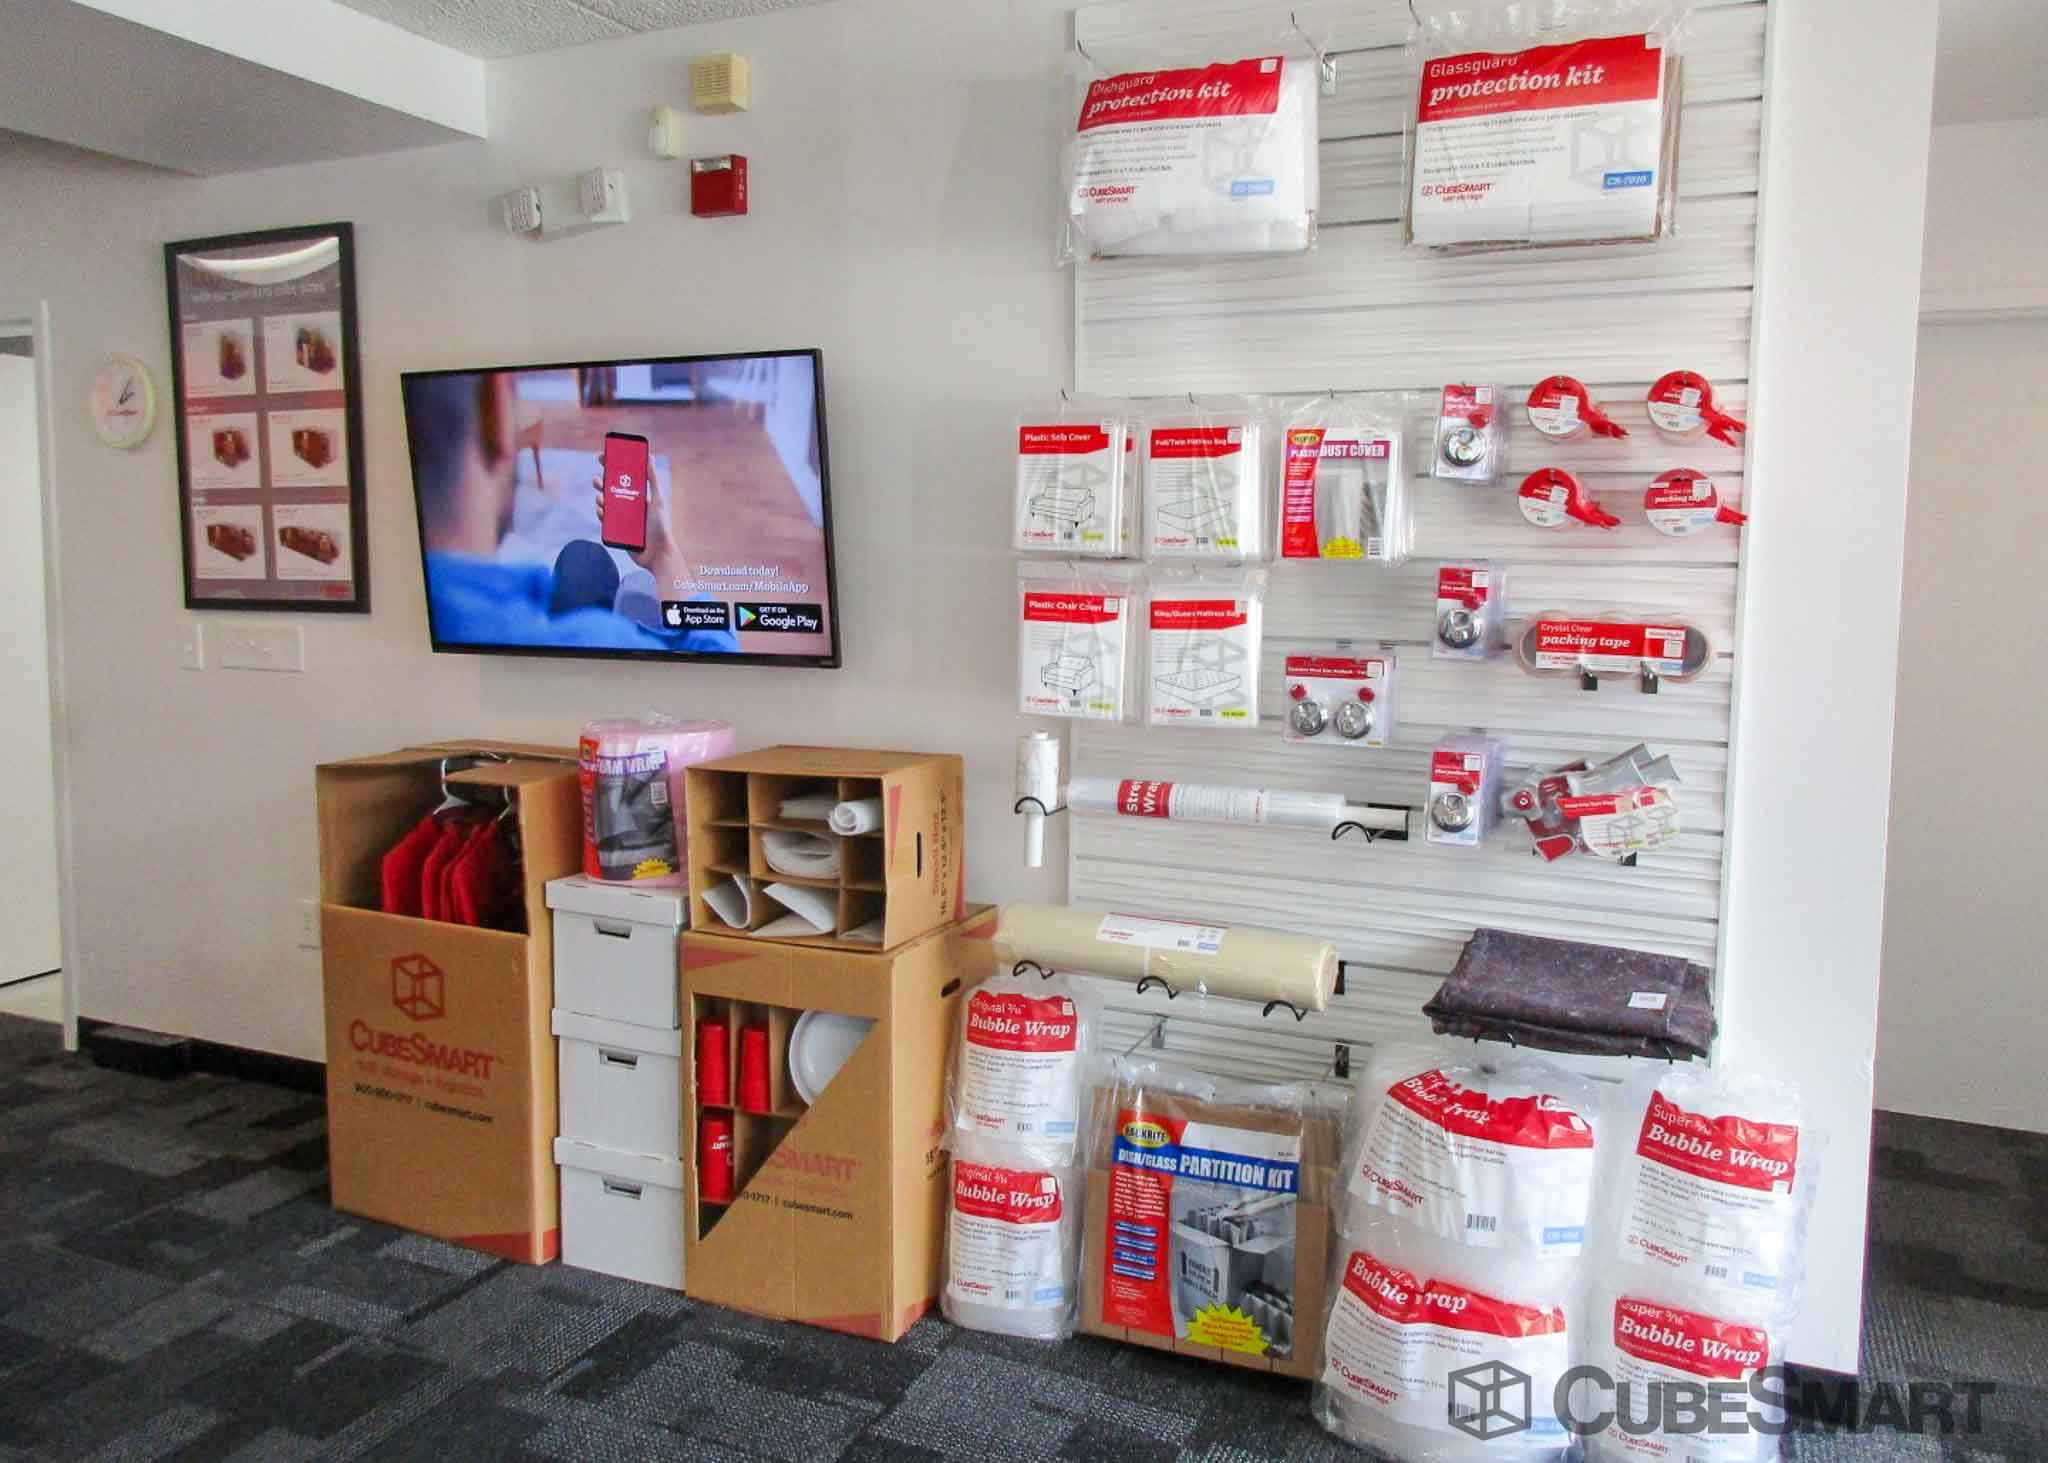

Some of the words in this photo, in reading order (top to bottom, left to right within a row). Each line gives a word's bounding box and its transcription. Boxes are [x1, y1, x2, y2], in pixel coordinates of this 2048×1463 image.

[1431, 55, 1518, 78] Glassguard
[1429, 70, 1561, 107] protection
[1565, 64, 1605, 86] kit
[1086, 87, 1194, 118] protection
[1197, 80, 1233, 98] kit
[1069, 433, 1091, 442] Cover
[1320, 444, 1347, 457] DUST
[1350, 444, 1385, 457] COVER
[699, 564, 748, 577] Download
[1029, 600, 1055, 610] Plastic
[1056, 601, 1078, 610] Chair
[685, 614, 703, 625] App
[704, 614, 725, 625] Store
[760, 614, 796, 629] Google
[797, 615, 818, 630] Play
[1540, 622, 1569, 633] Crystal
[1570, 623, 1593, 633] Clear
[1541, 634, 1597, 648] packing
[1599, 636, 1630, 648] tape
[970, 1013, 1021, 1034] Bubble
[1024, 1020, 1071, 1038] Wrap
[1653, 1103, 1692, 1128] Super
[1647, 1123, 1724, 1162] Bubble
[1728, 1147, 1789, 1177] Wrap
[1118, 1148, 1177, 1171] DISH/GLASS
[1179, 1153, 1265, 1186] PARTITION
[1267, 1166, 1294, 1190] KIT
[956, 1180, 1006, 1204] Bubble
[1009, 1190, 1055, 1209] Wrap
[1352, 1257, 1409, 1306] Bubble
[1619, 1315, 1696, 1352] Bubble
[1701, 1337, 1762, 1366] Wrap
